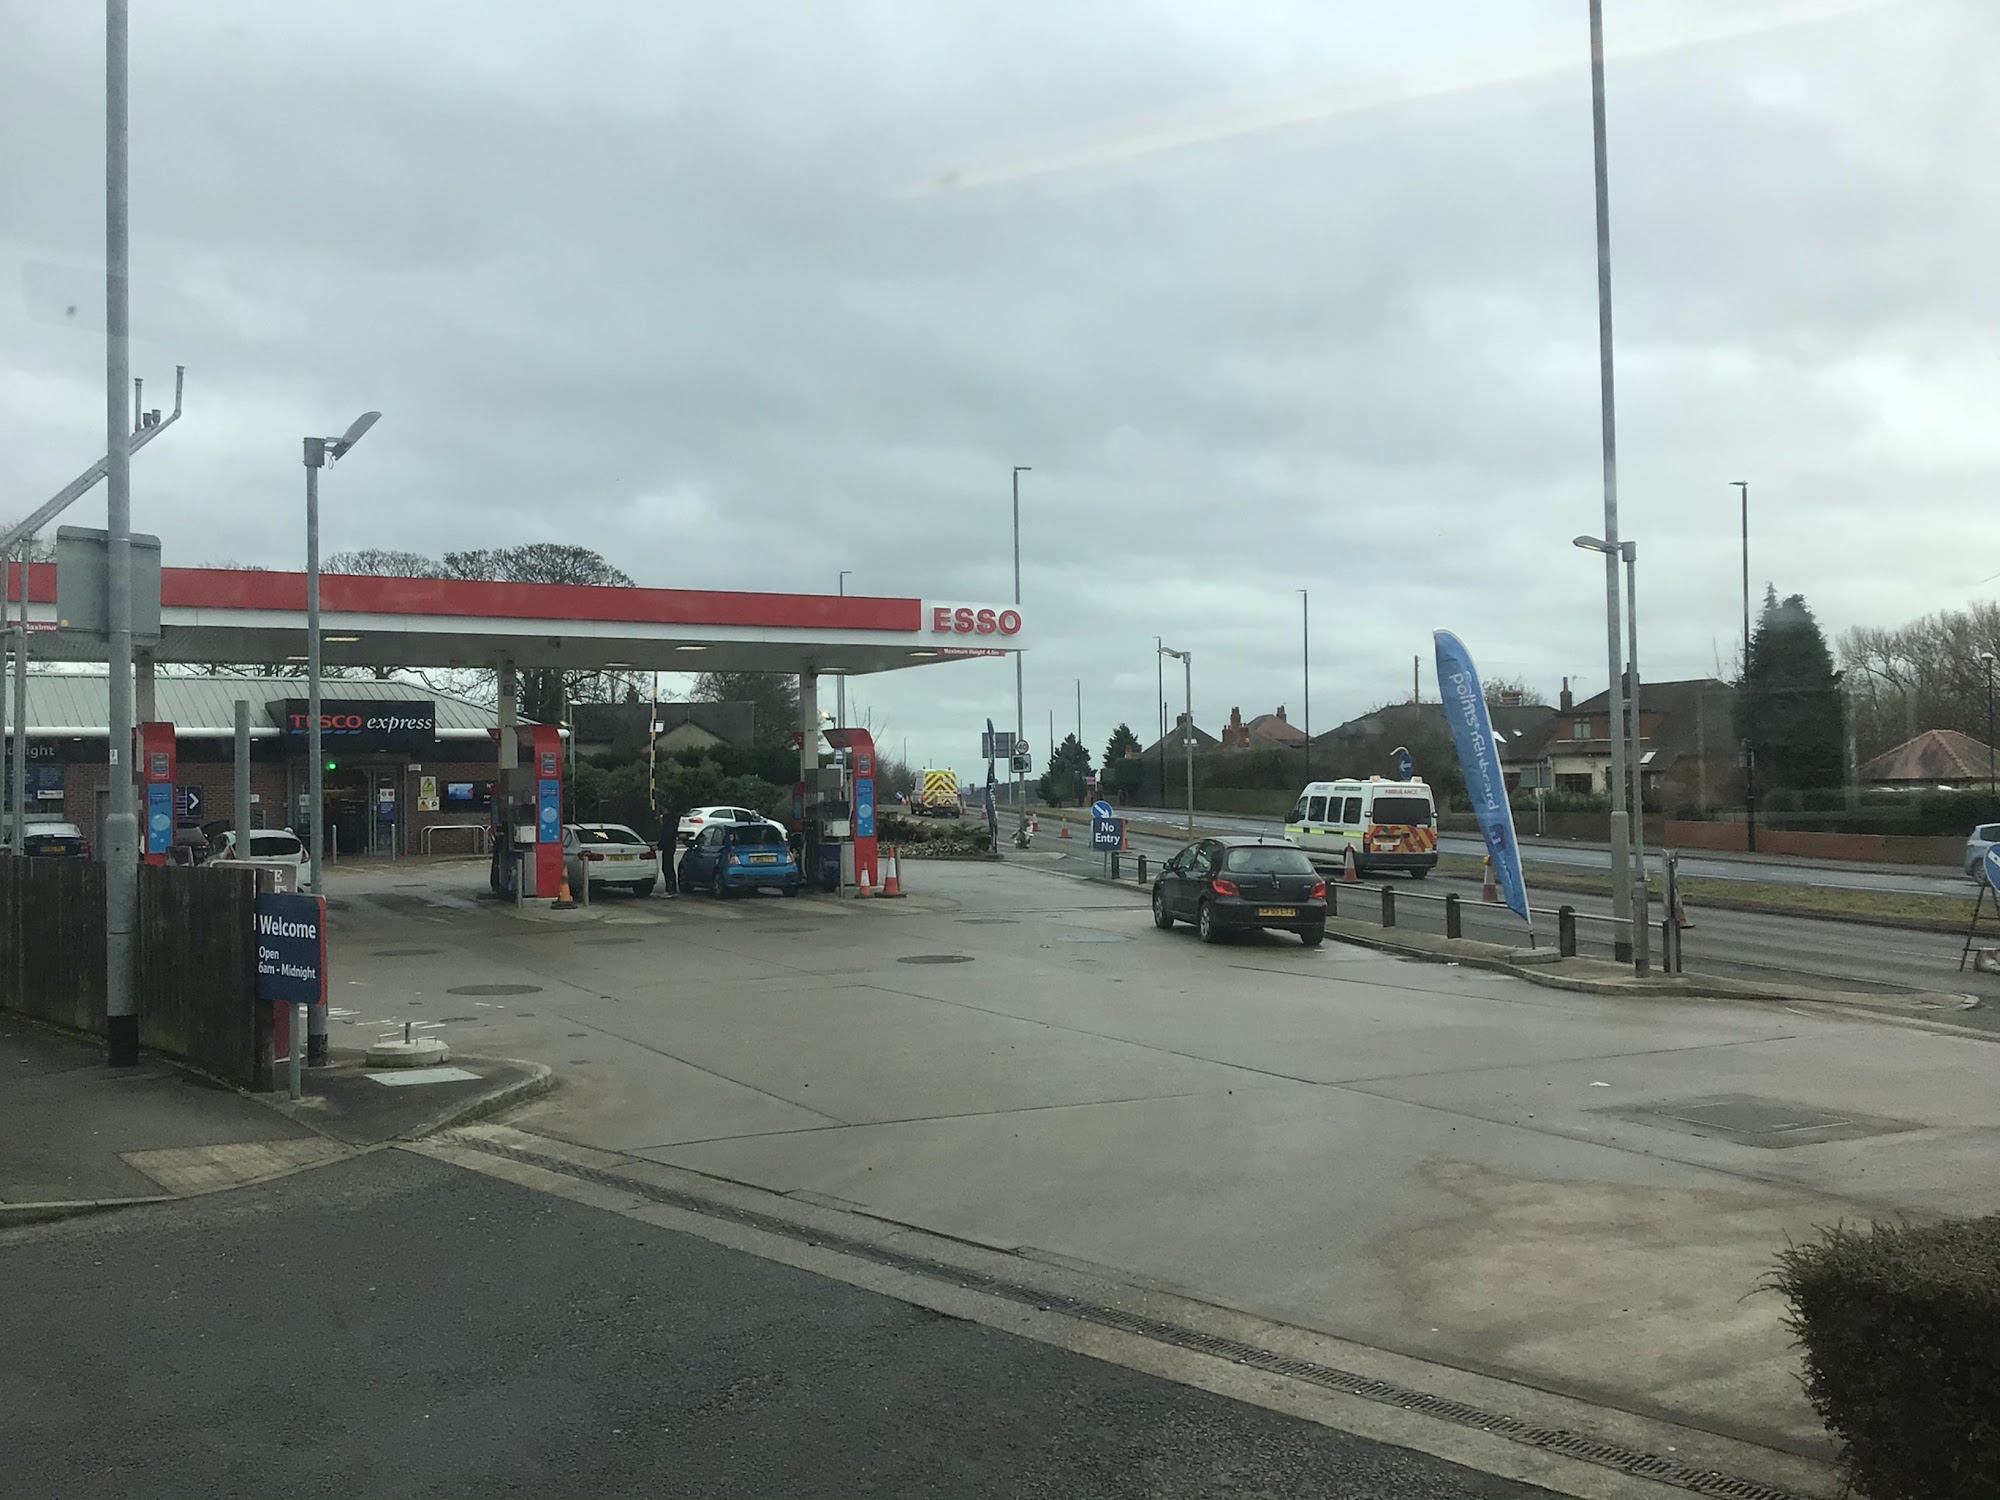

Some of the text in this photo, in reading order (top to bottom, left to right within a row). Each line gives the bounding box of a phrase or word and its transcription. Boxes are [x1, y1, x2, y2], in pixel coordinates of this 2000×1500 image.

[933, 607, 1022, 635] ESSO
[968, 648, 986, 656] Height
[366, 715, 433, 733] express
[1101, 821, 1115, 832] No
[1095, 832, 1120, 845] Entry
[259, 914, 316, 940] Welcome
[258, 946, 280, 961] Open
[258, 961, 275, 975] 6am
[281, 963, 316, 981] Midnight
